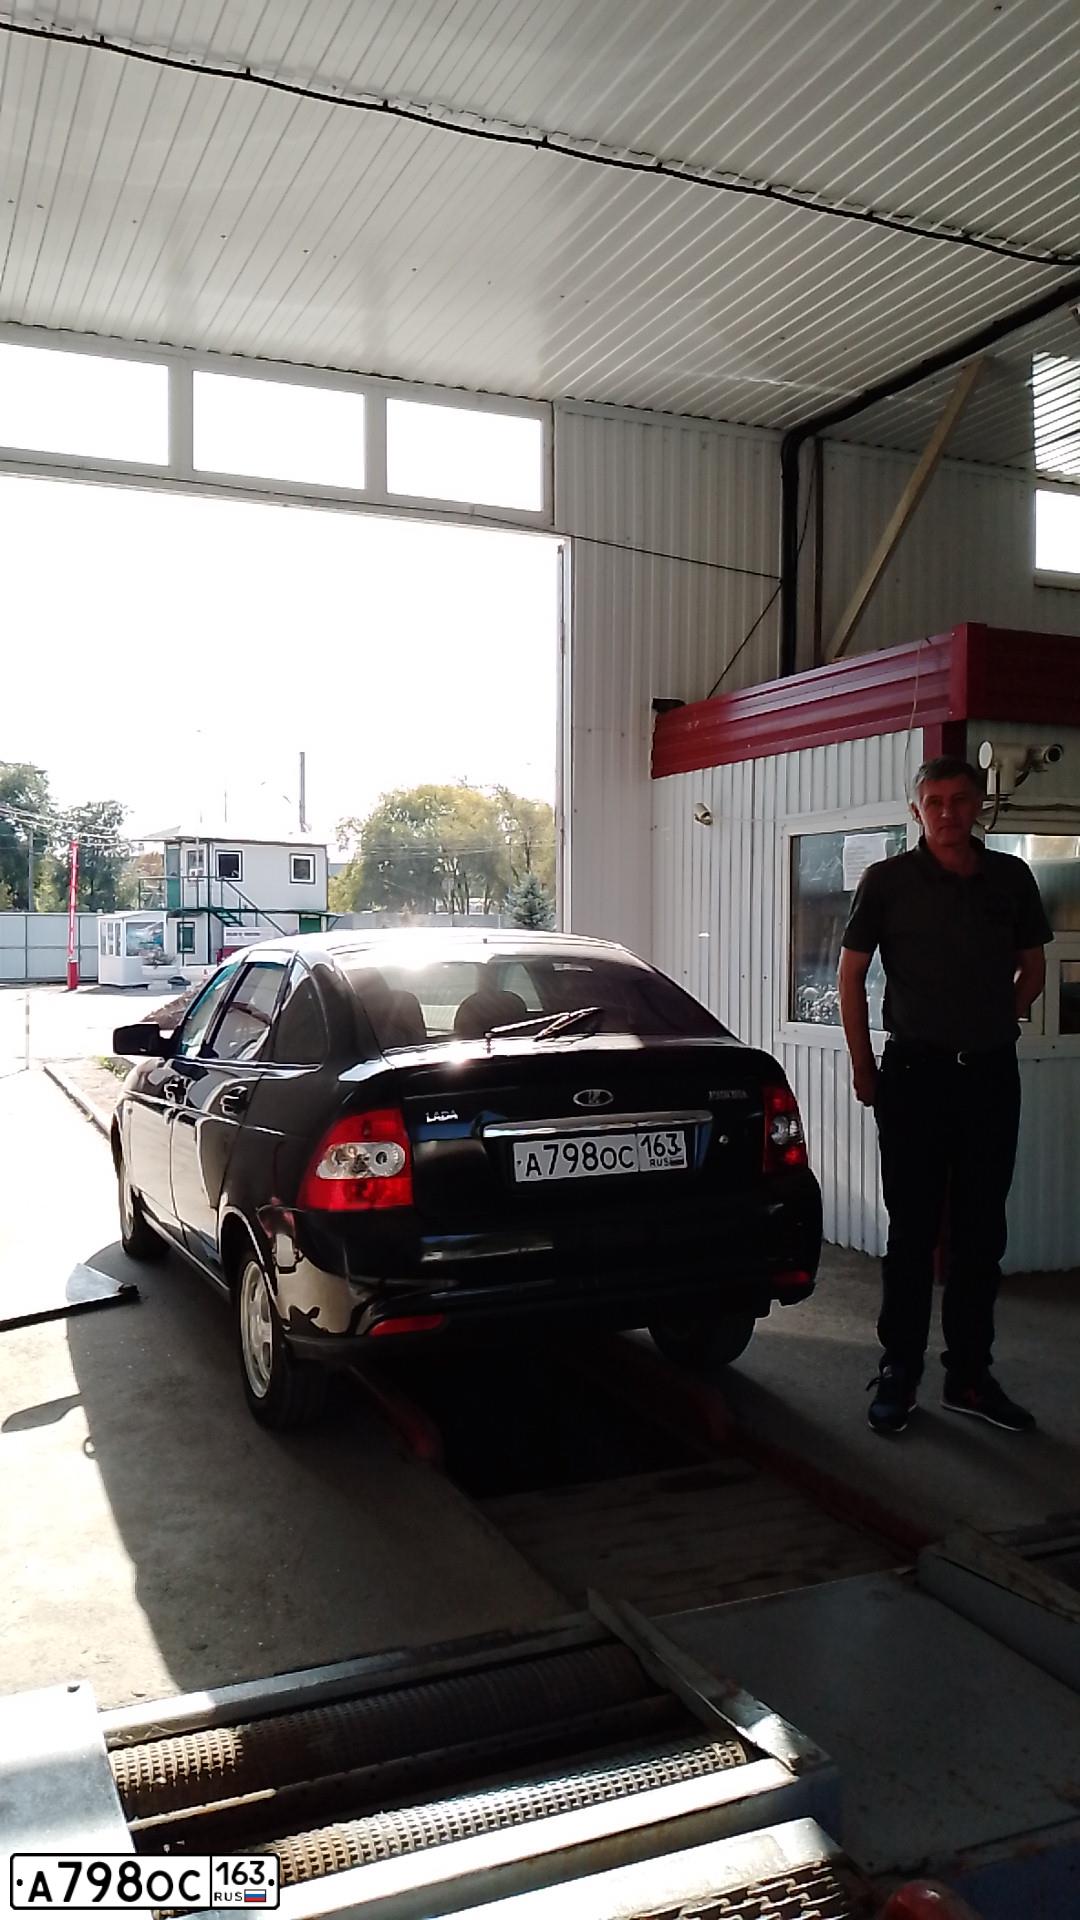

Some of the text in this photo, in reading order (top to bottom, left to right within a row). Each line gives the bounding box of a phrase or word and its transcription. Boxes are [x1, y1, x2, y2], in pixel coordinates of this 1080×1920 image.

[525, 1133, 682, 1177] A798OC 163
[649, 1157, 670, 1168] RUS
